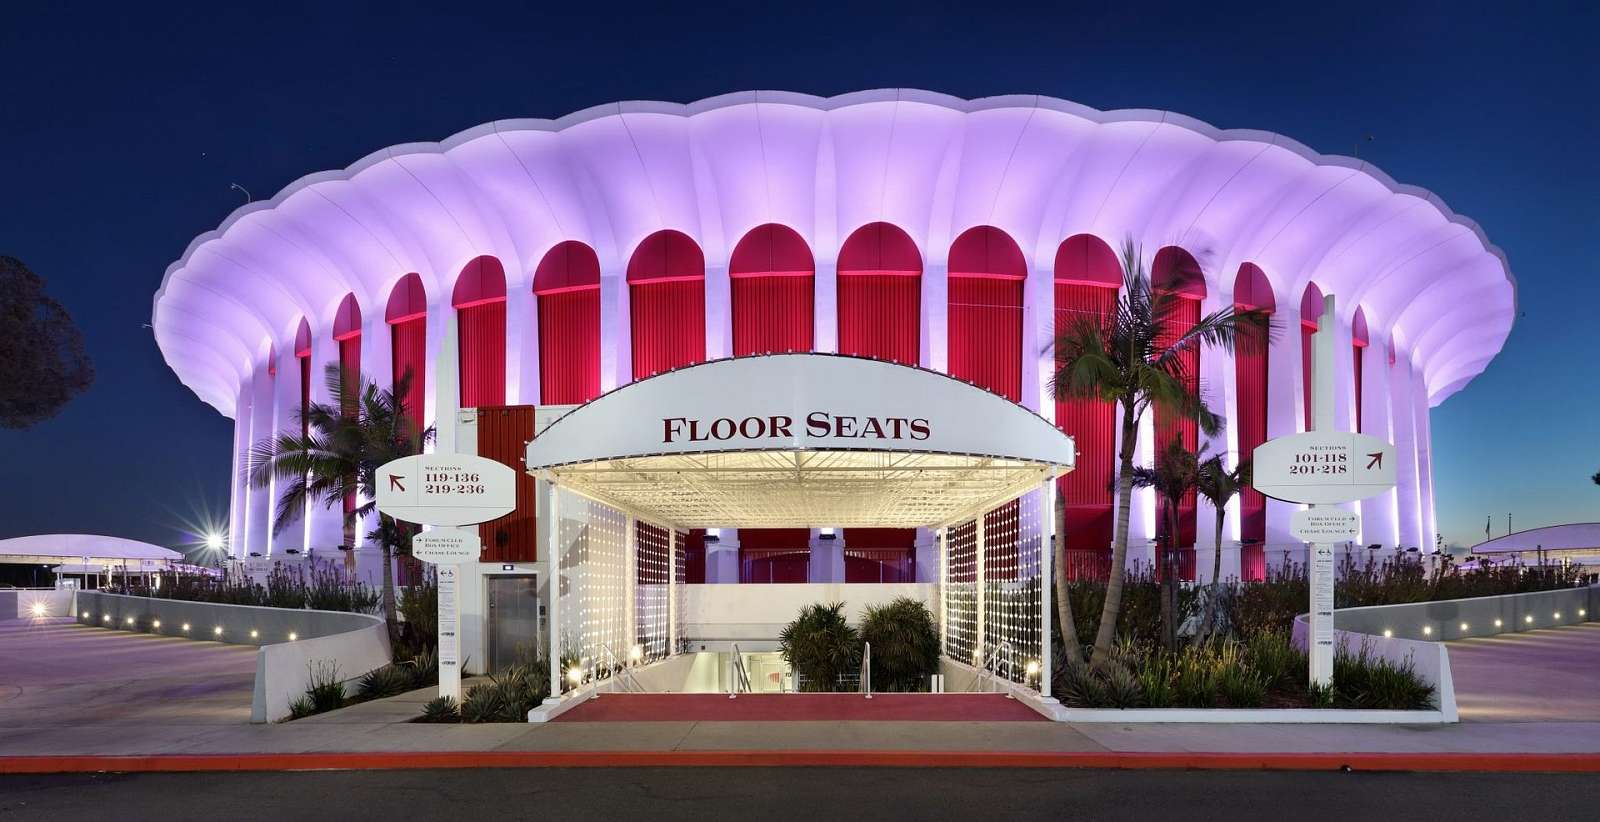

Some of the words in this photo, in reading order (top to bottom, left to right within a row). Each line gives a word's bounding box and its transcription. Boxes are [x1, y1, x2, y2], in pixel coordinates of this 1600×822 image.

[662, 415, 794, 443] FLOOR
[806, 411, 931, 441] SEATS
[1295, 453, 1347, 463] 101-118
[1289, 464, 1347, 474] 201-218
[426, 473, 480, 482] 119-136
[425, 484, 485, 494] 219-236
